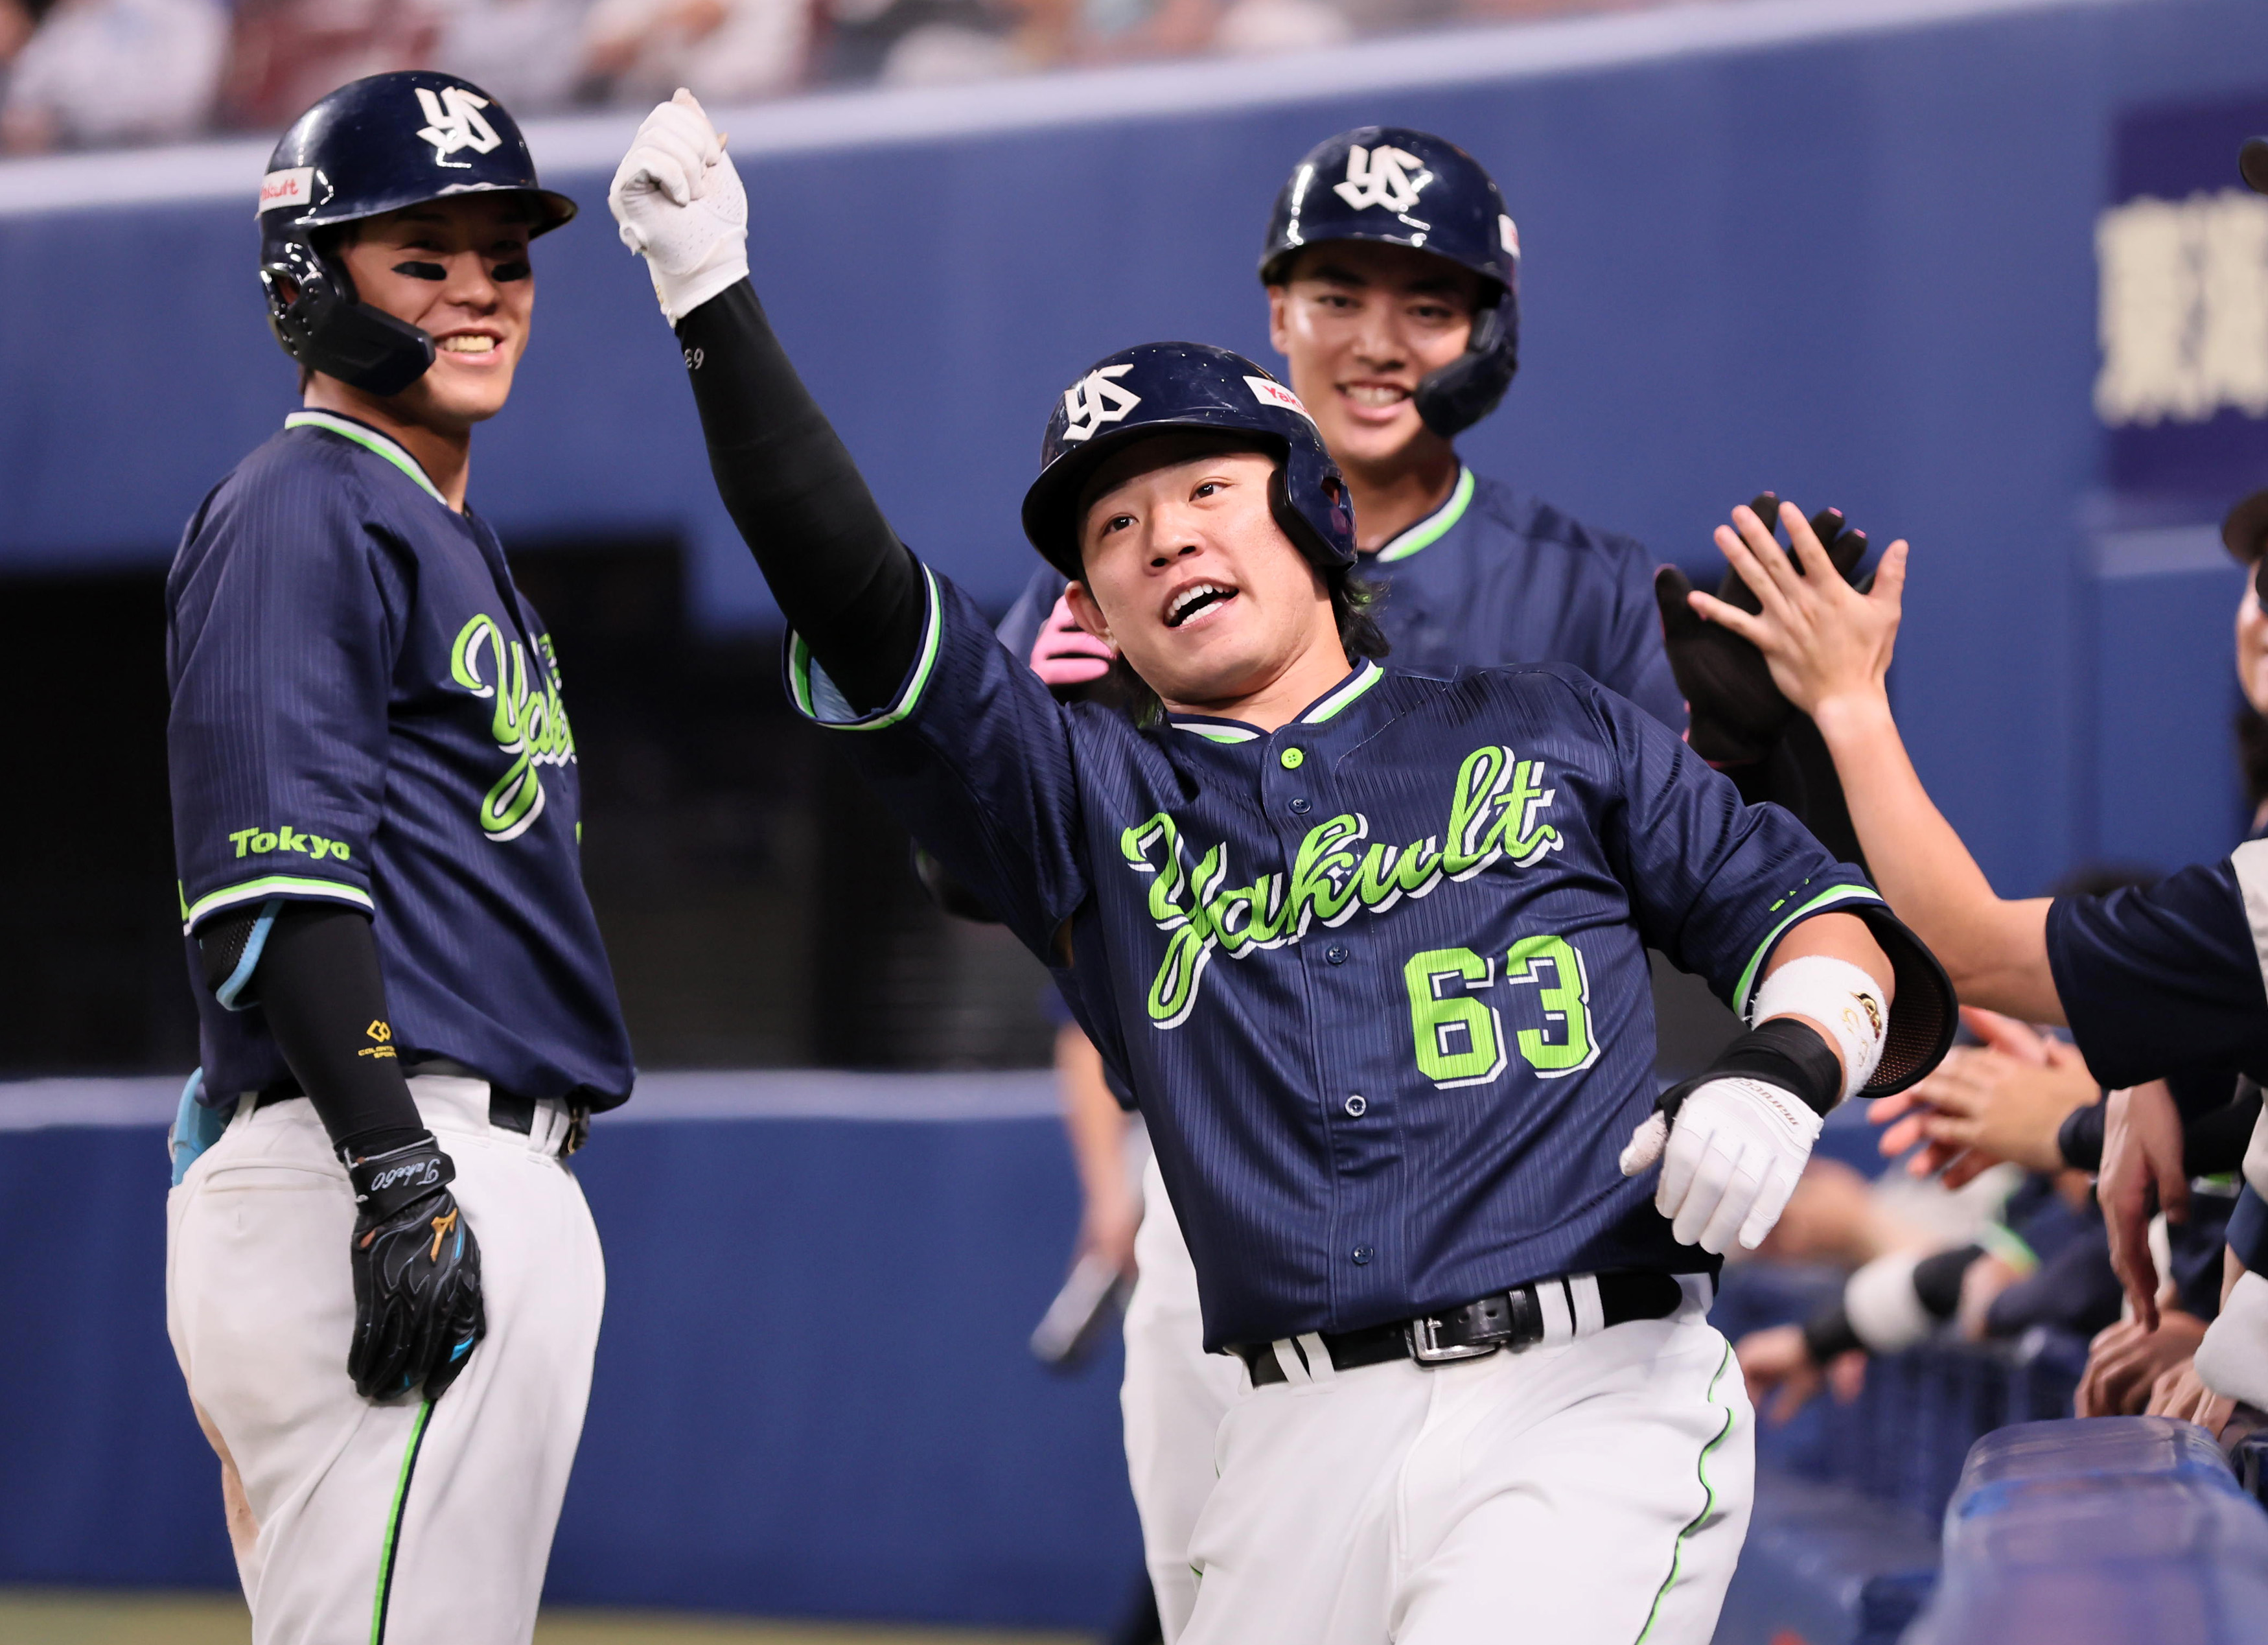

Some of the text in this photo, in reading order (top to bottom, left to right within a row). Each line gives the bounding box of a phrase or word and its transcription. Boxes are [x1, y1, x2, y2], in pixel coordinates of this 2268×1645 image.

[260, 179, 299, 202] akult
[229, 826, 351, 861] Tokyo
[1120, 745, 1564, 1030] Yakult
[1404, 934, 1601, 1090] 63
